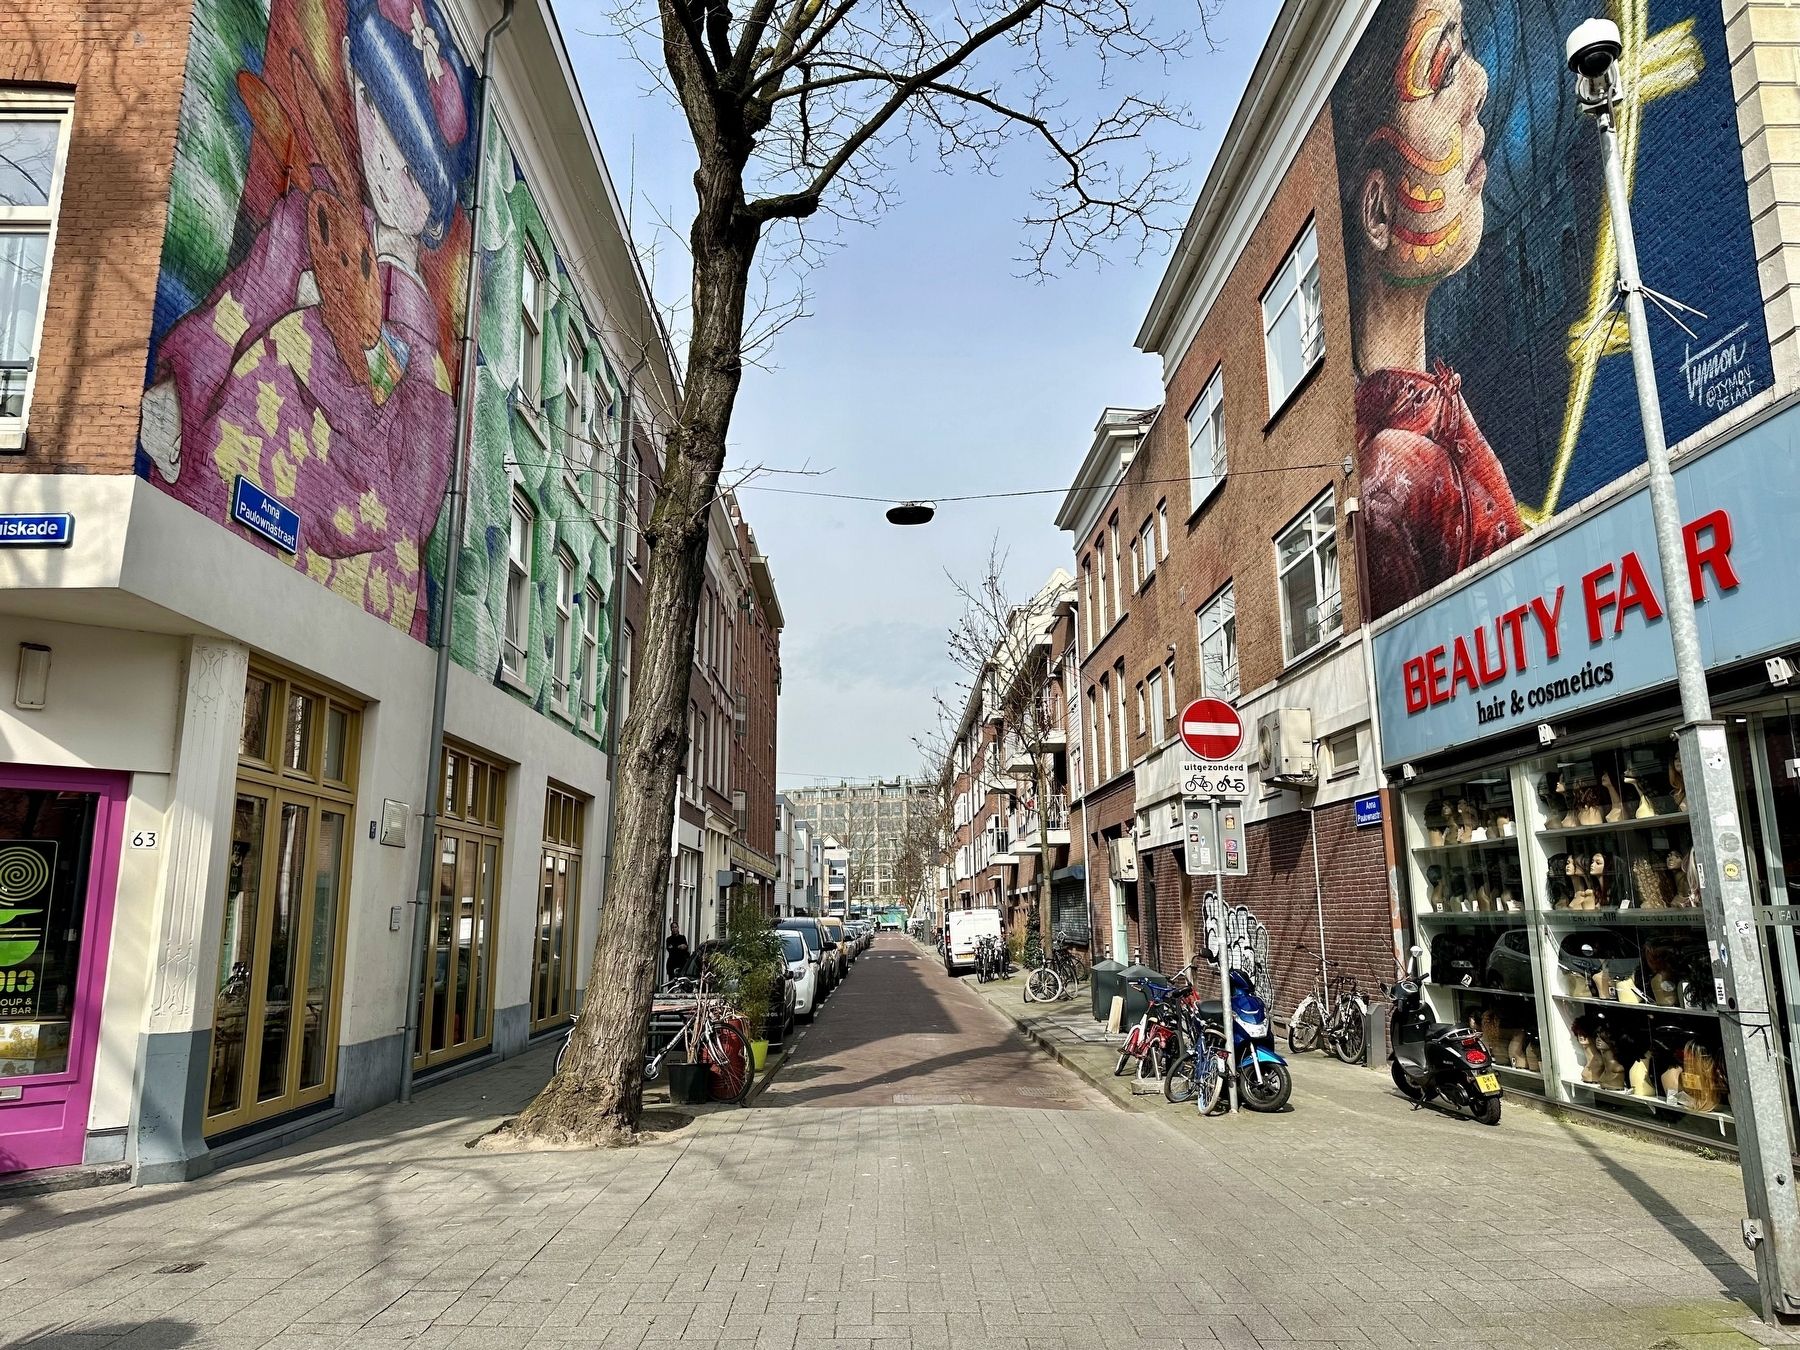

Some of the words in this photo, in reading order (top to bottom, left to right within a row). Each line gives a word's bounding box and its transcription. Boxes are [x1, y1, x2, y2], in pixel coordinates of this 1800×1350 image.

[261, 498, 280, 520] Anna
[239, 501, 295, 547] Paulownastraat
[1403, 585, 1565, 714] BEAUTY
[1582, 508, 1740, 643] FAR
[1477, 696, 1506, 724] hair
[1511, 690, 1524, 715] &
[1527, 661, 1614, 708] cosmetics
[1184, 764, 1244, 772] uitgezonderd
[133, 832, 156, 847] 63
[25, 997, 33, 1005] &
[11, 1006, 32, 1015] BAR
